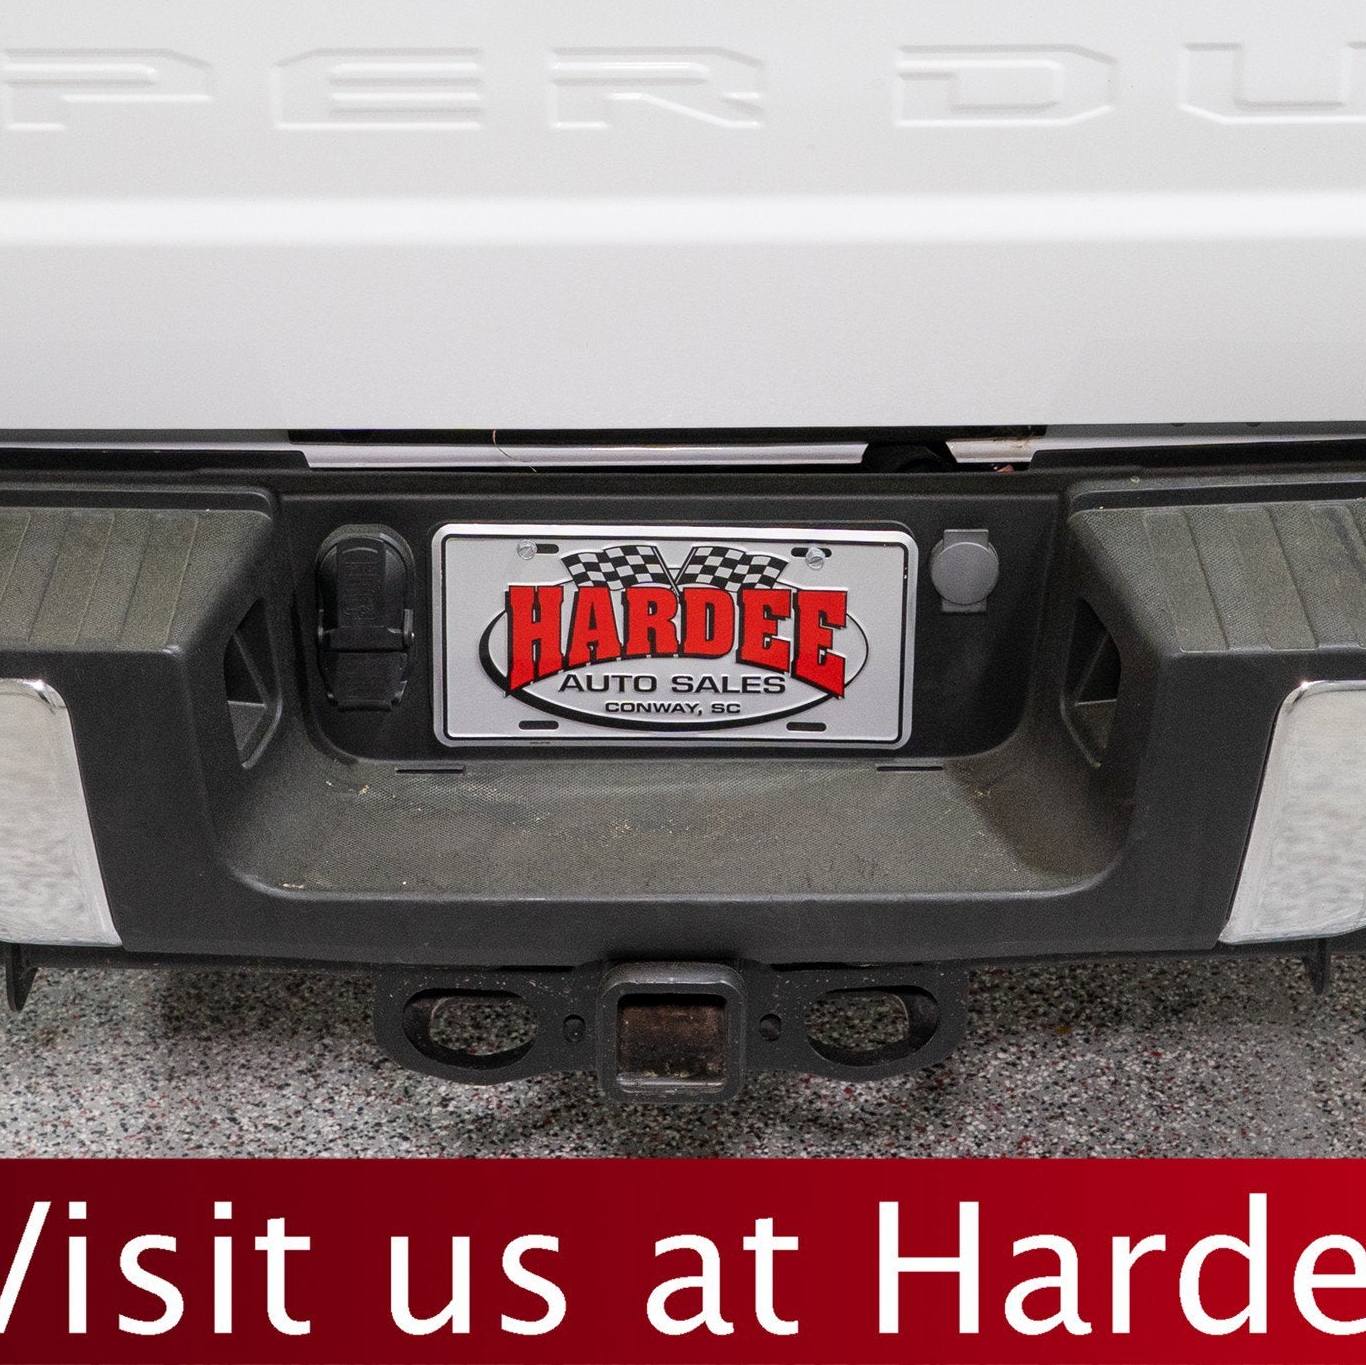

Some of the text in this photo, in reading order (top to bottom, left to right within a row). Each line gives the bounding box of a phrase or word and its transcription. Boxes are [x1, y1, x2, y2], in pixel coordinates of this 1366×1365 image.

[505, 584, 848, 698] HARDEE
[558, 673, 786, 695] AUTO SALES
[604, 700, 741, 716] CONWAY, SC
